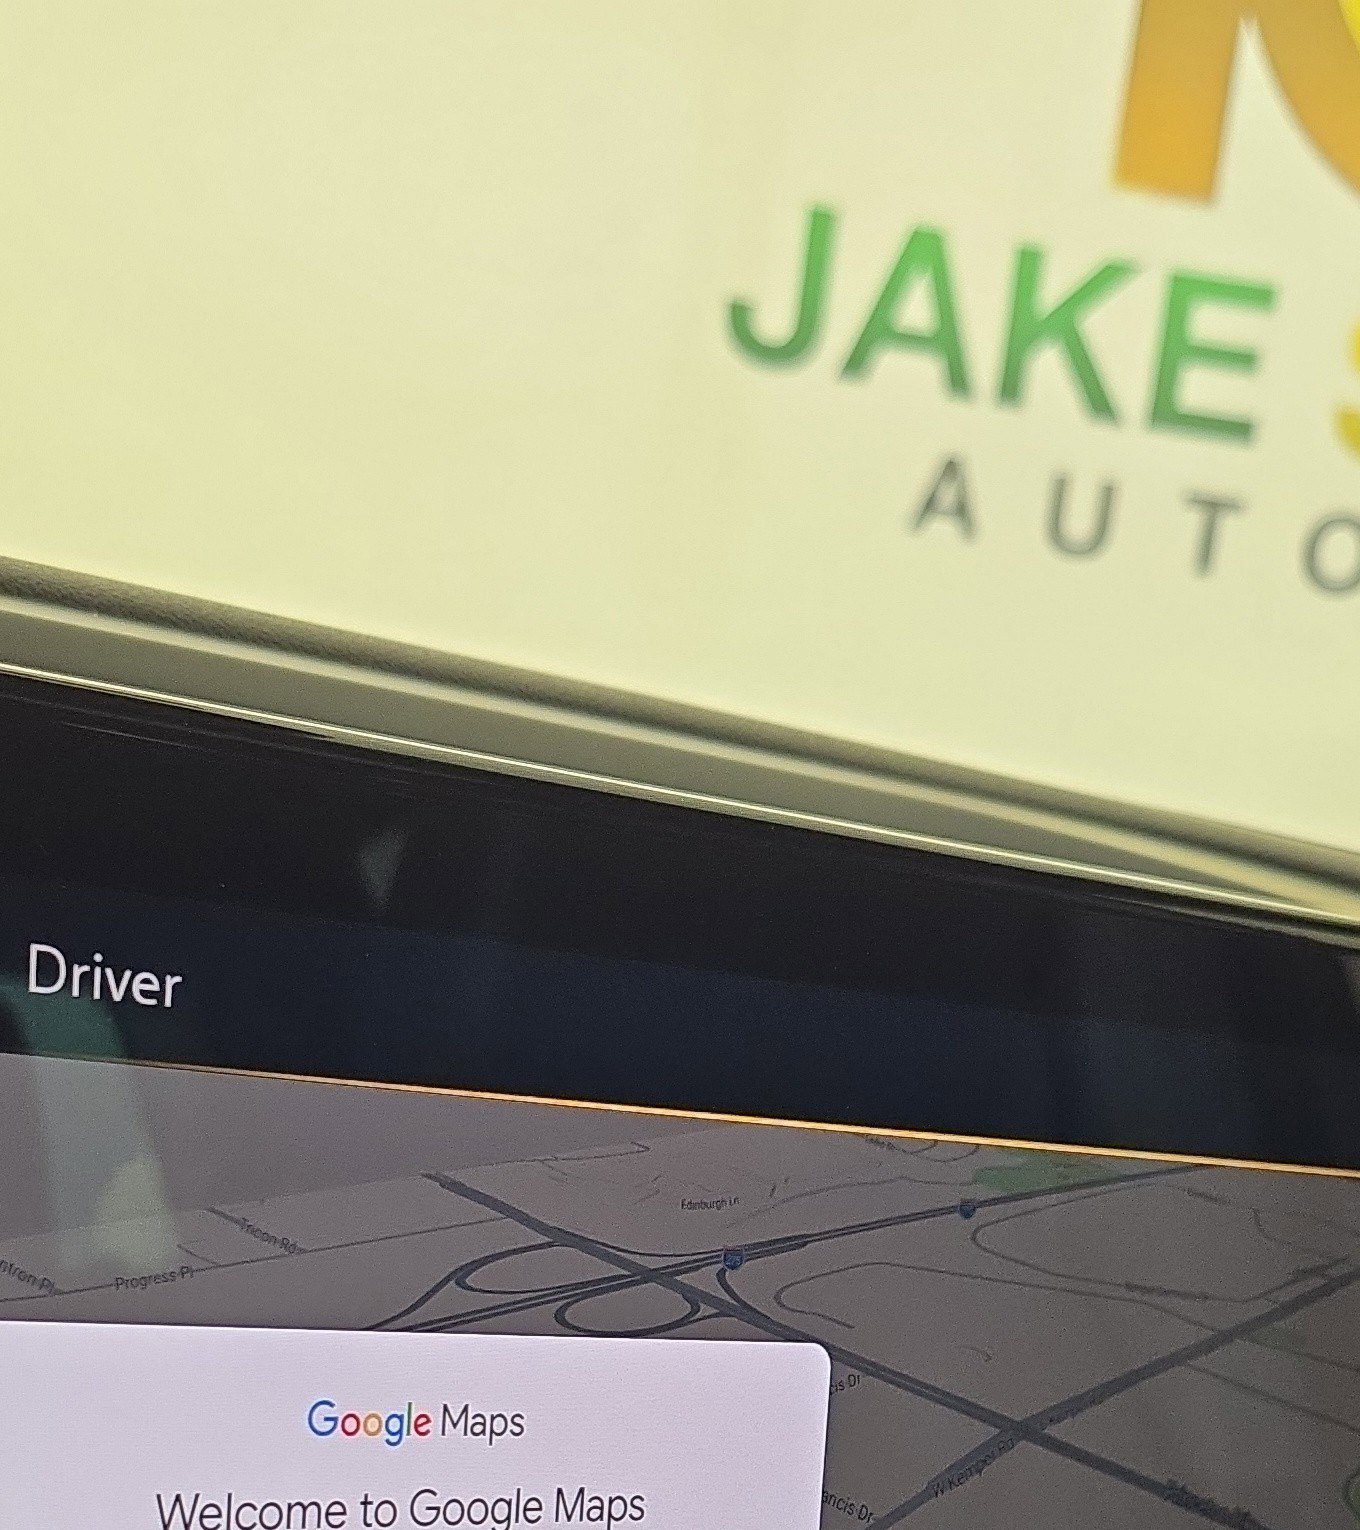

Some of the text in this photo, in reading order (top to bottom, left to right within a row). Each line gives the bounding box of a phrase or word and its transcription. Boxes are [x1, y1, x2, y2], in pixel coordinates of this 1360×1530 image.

[727, 206, 1277, 445] JAKE
[28, 942, 184, 1008] Driver
[115, 1270, 177, 1291] Progress
[307, 1399, 525, 1447] Google Maps
[359, 1493, 398, 1528] to
[554, 1486, 645, 1528] Maps
